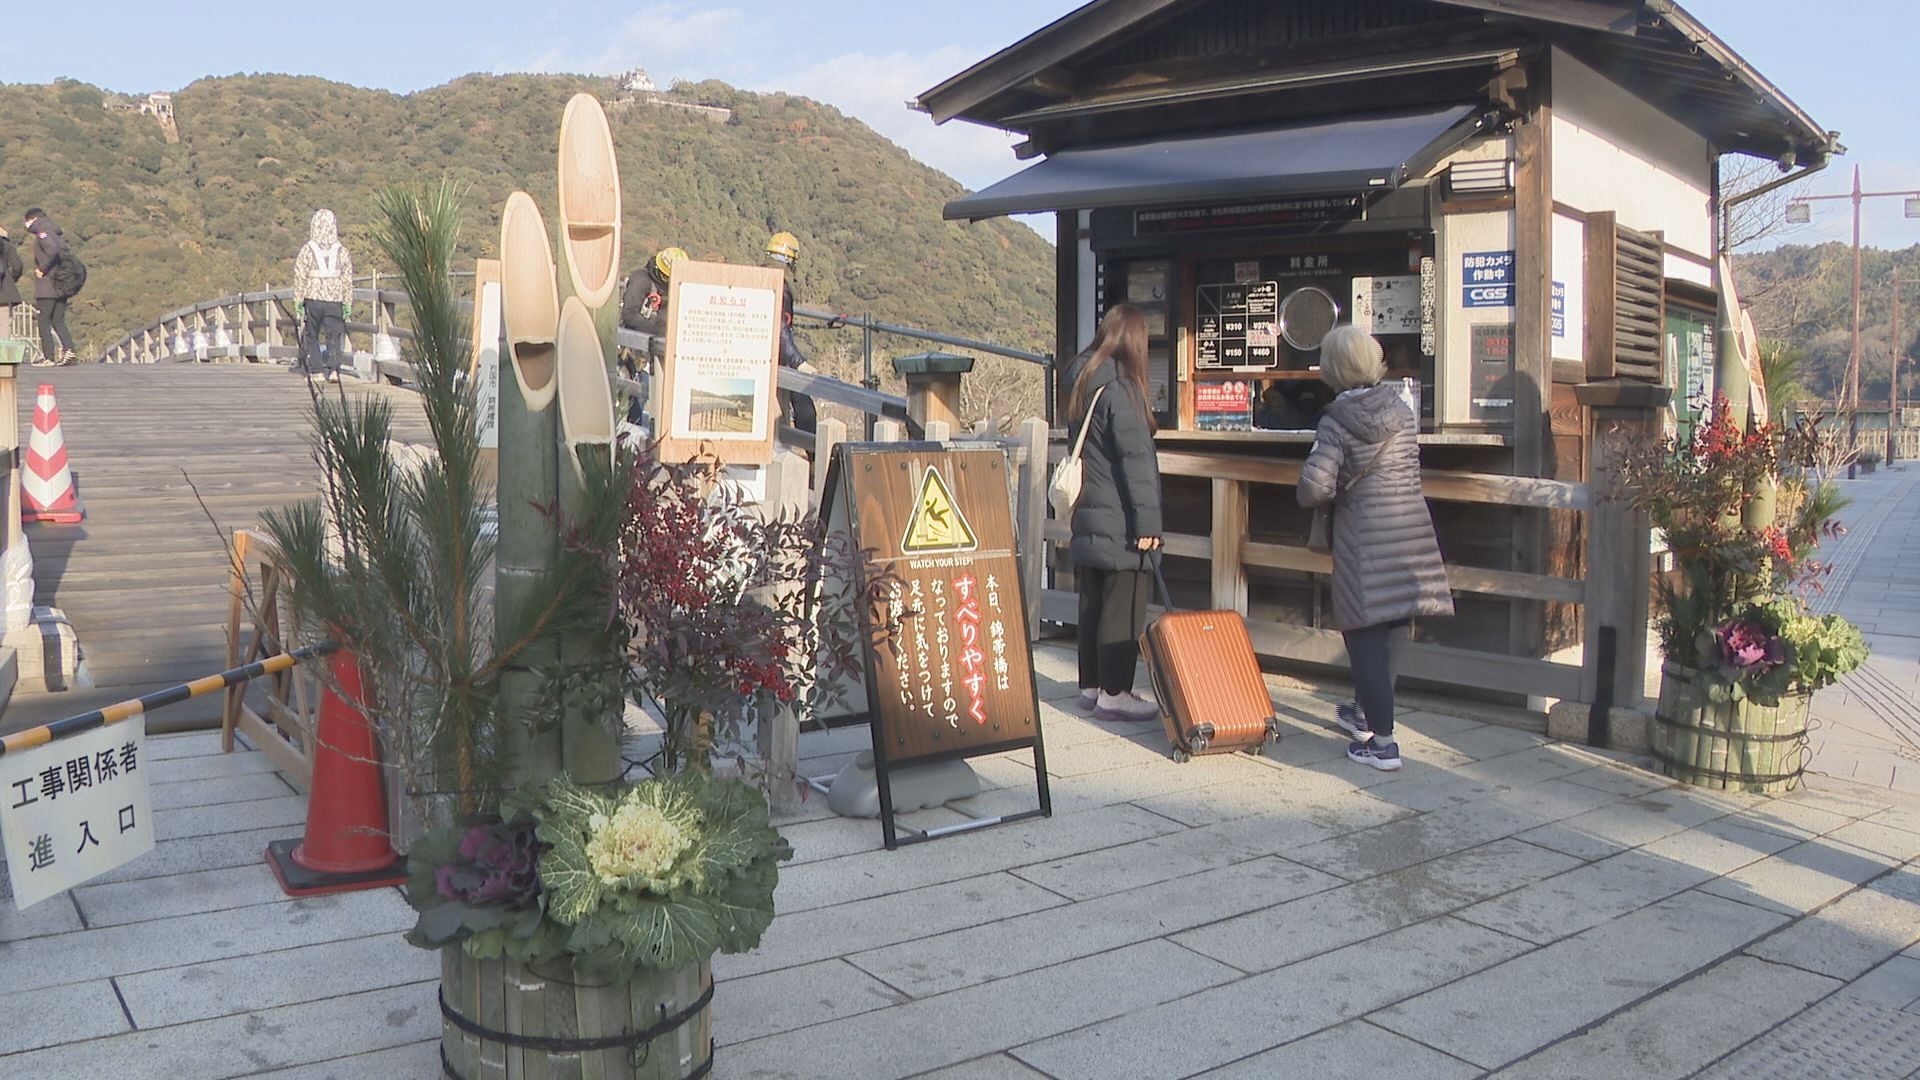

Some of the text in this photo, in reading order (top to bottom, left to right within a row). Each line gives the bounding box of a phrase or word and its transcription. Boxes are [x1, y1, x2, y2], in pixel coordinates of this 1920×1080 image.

[1290, 255, 1328, 268] 料金所
[1464, 255, 1513, 268] 防犯カメラ
[1473, 268, 1505, 281] 作動中
[709, 295, 748, 305] お知らせ
[1470, 287, 1508, 301] CGS
[1225, 322, 1243, 331] ¥310
[1225, 348, 1243, 357] ¥150
[909, 556, 974, 569] WATCH YOUR STEP!
[985, 574, 1010, 691] 本日、錦帯橋は
[909, 579, 935, 718] 足元に気をつけて
[930, 578, 960, 729] なっておりますので
[953, 574, 986, 723] すべりやすく
[12, 740, 138, 809] 工事関係者
